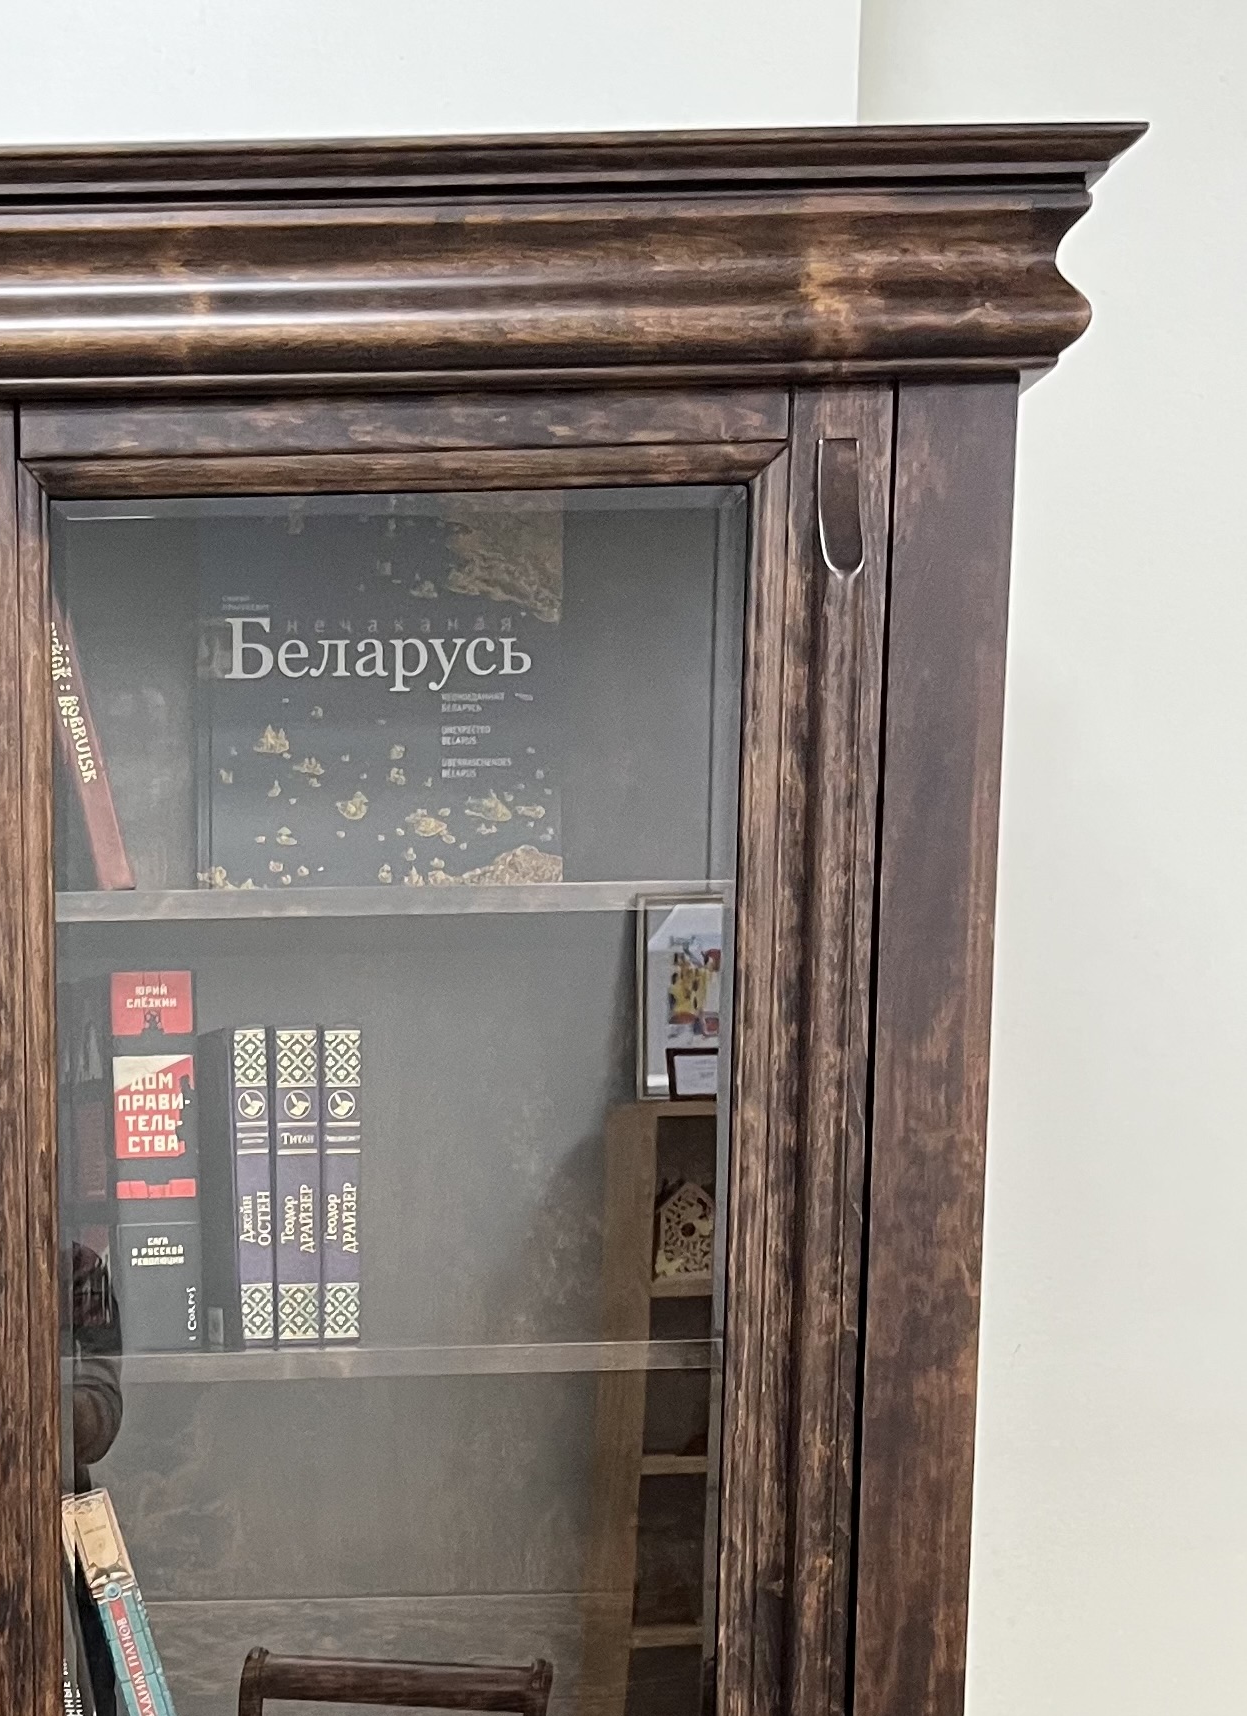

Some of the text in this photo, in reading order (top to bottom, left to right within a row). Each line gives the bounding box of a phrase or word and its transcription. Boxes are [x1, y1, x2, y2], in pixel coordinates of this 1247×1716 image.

[223, 616, 532, 692] Беларусь
[135, 983, 168, 996] ЮРИЙ
[118, 1093, 190, 1112] ПРАВИ-
[130, 1072, 173, 1092] ДОМ
[125, 1114, 183, 1132] ТЕЛЬ-
[128, 1135, 179, 1153] СТВА
[239, 1195, 256, 1243] Джейн
[256, 1190, 272, 1246] ОСТЕН
[280, 1195, 299, 1244] Теодор
[298, 1184, 316, 1254] ДРАЙЗЕР
[324, 1193, 341, 1244] Теодор
[341, 1182, 359, 1254] ДРАЙЗЕР
[116, 1617, 140, 1668] ПАНОВ
